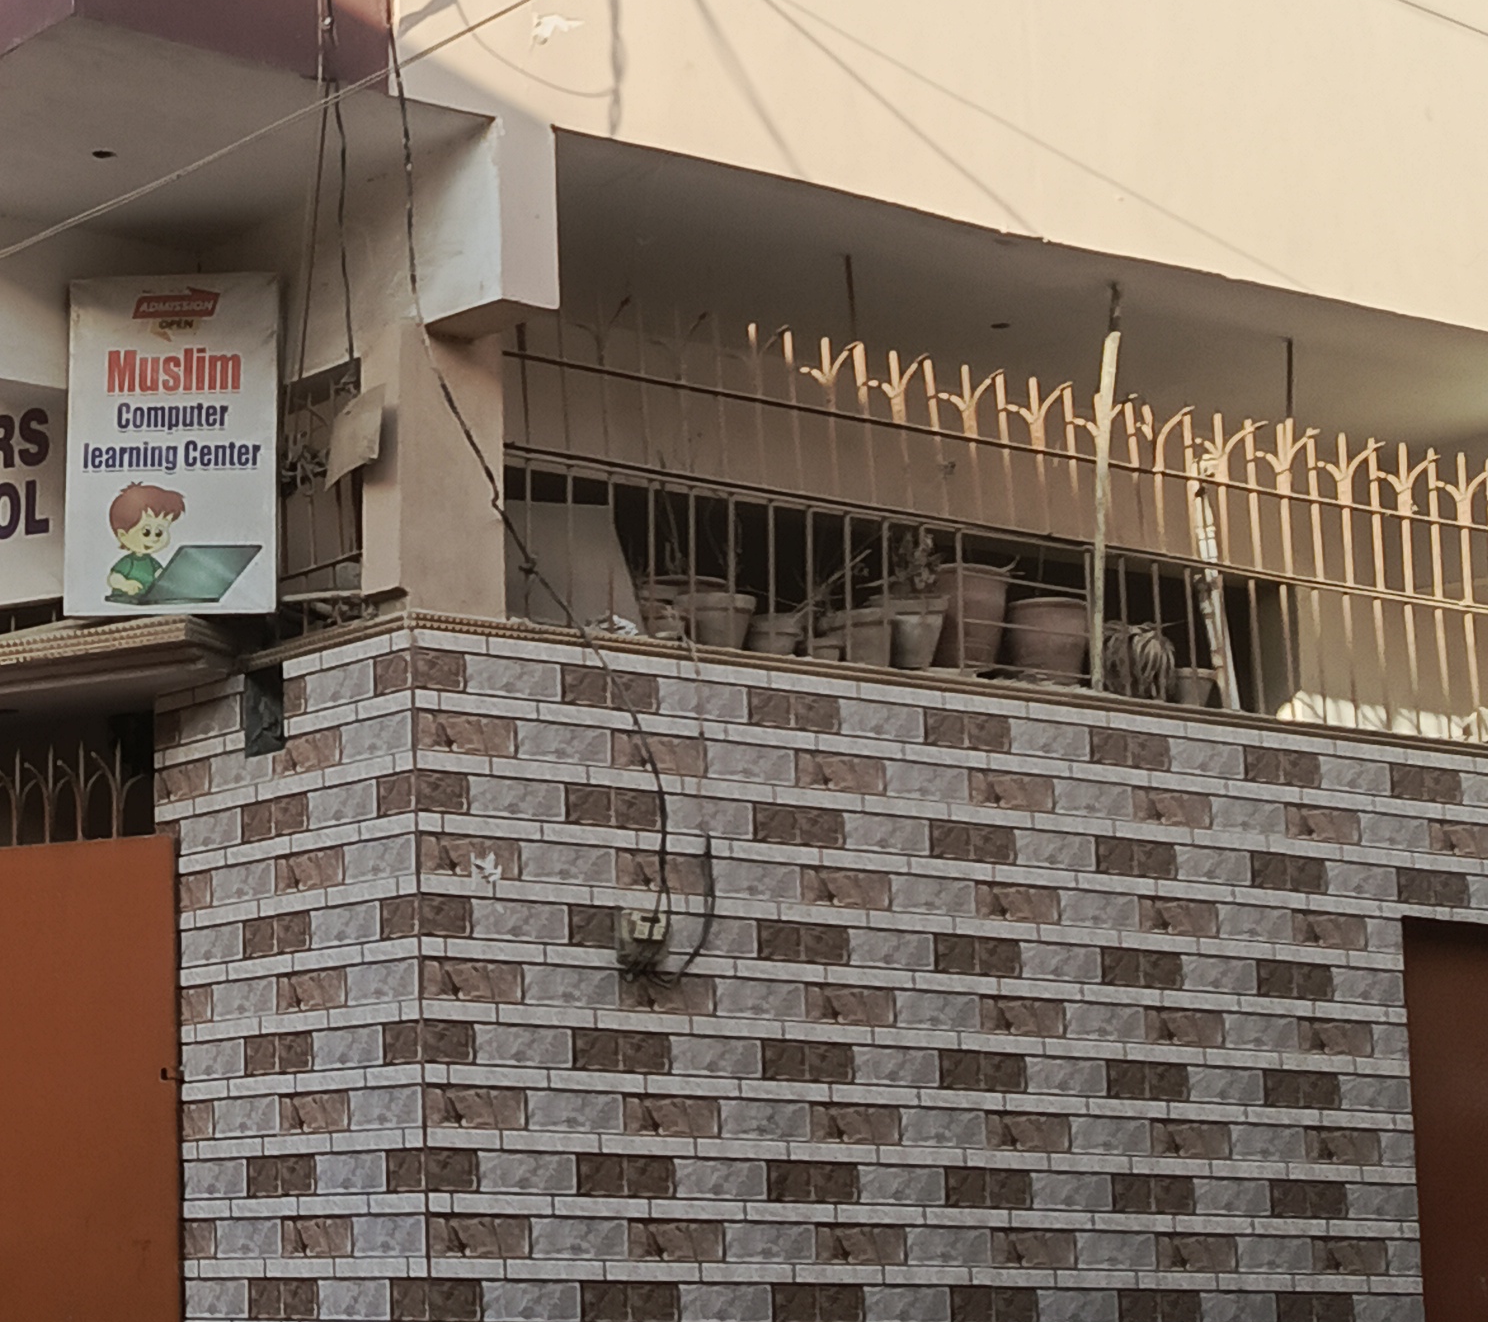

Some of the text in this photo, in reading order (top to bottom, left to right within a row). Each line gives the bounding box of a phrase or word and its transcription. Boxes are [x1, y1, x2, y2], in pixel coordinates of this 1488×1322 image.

[139, 299, 214, 312] ADMISSION
[158, 319, 194, 330] OPEN
[106, 347, 242, 394] Muslim
[117, 402, 229, 431] Computer
[82, 440, 262, 471] learning Center
